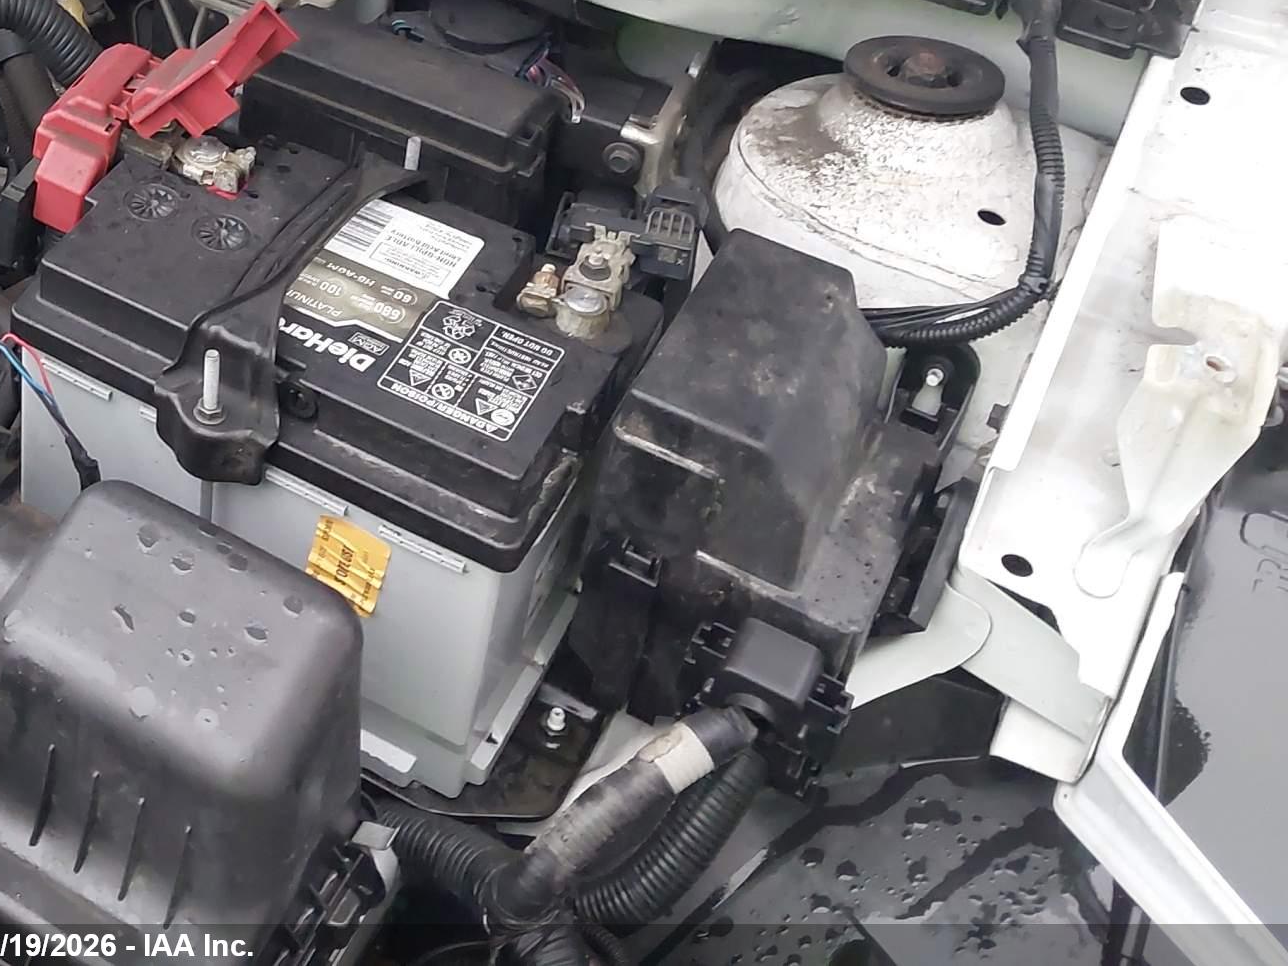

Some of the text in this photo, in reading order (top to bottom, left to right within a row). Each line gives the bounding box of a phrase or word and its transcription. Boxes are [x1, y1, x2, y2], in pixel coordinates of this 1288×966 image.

[319, 279, 342, 295] 100
[372, 300, 401, 320] 680
[389, 382, 487, 429] DANGER/POISON
